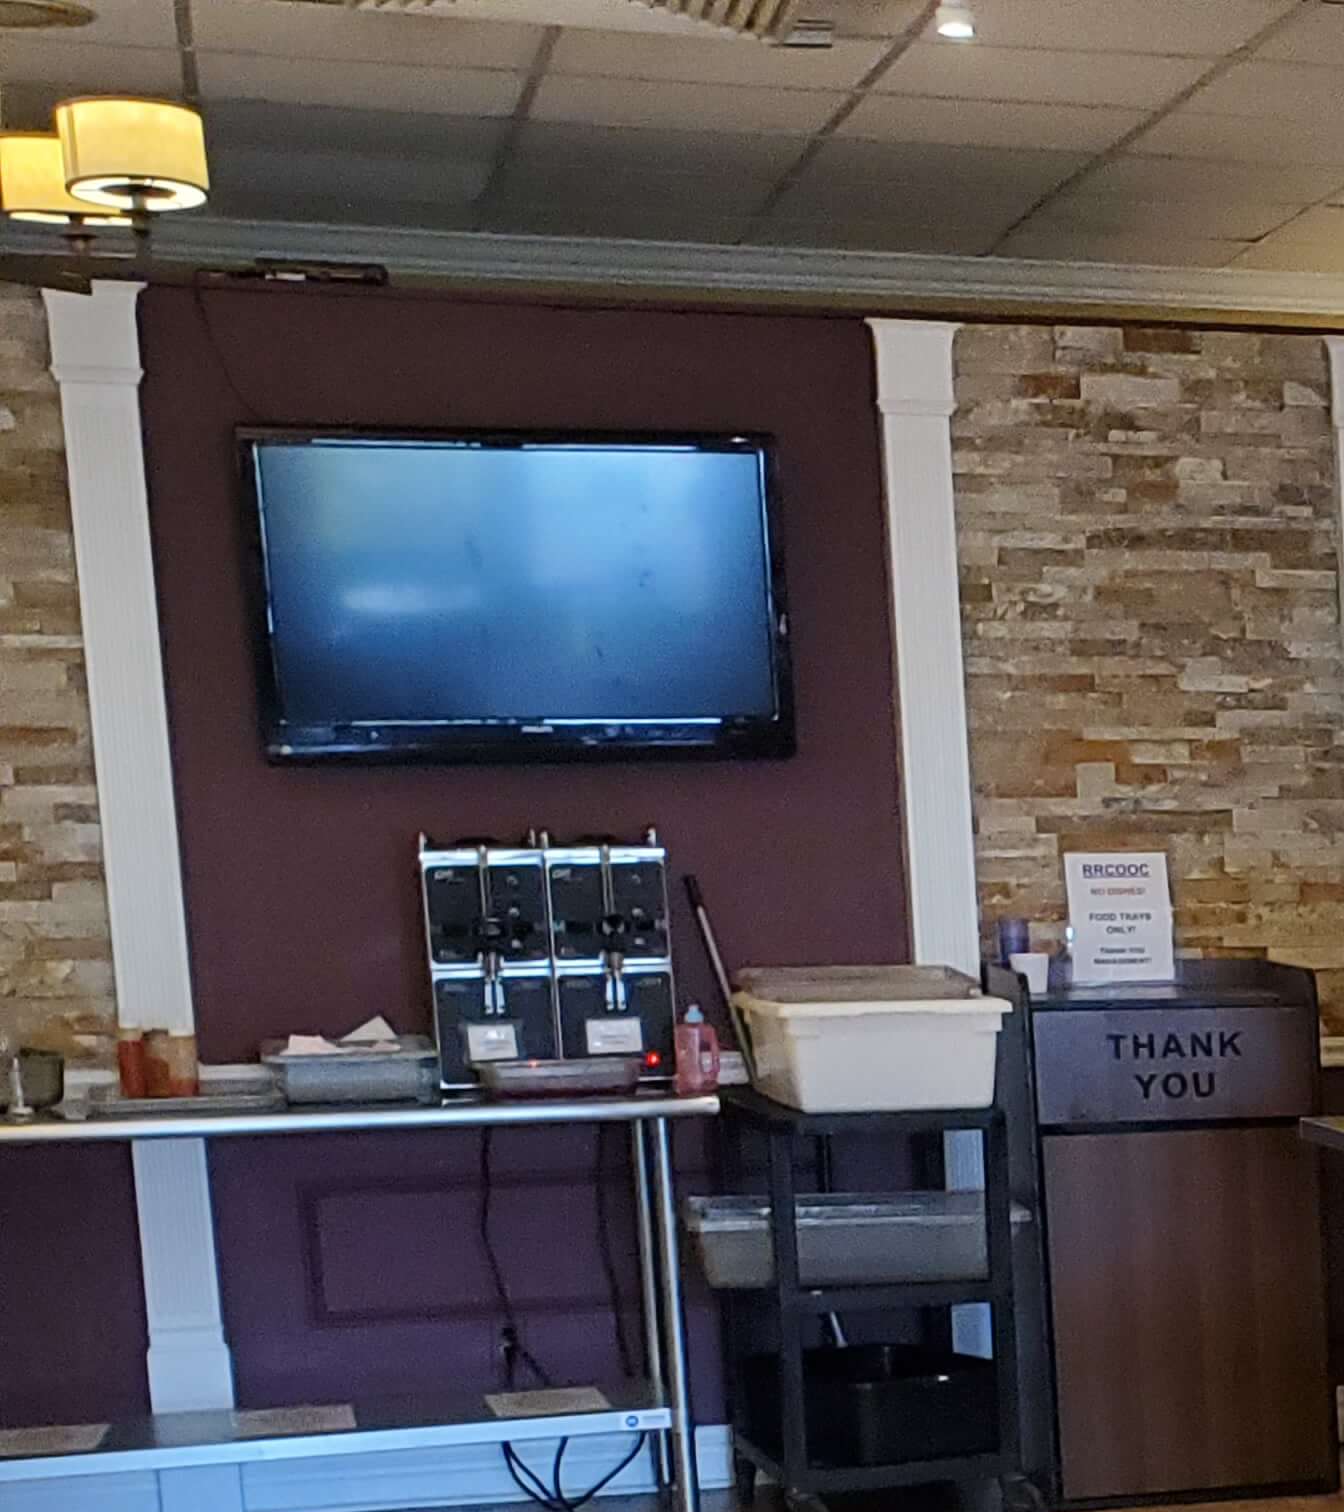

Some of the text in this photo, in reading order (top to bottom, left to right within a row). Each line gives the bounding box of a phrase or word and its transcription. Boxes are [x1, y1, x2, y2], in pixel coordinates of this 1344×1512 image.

[1089, 912, 1117, 921] FOOD
[1106, 1031, 1244, 1060] THANK
[1134, 1071, 1217, 1100] YOU
